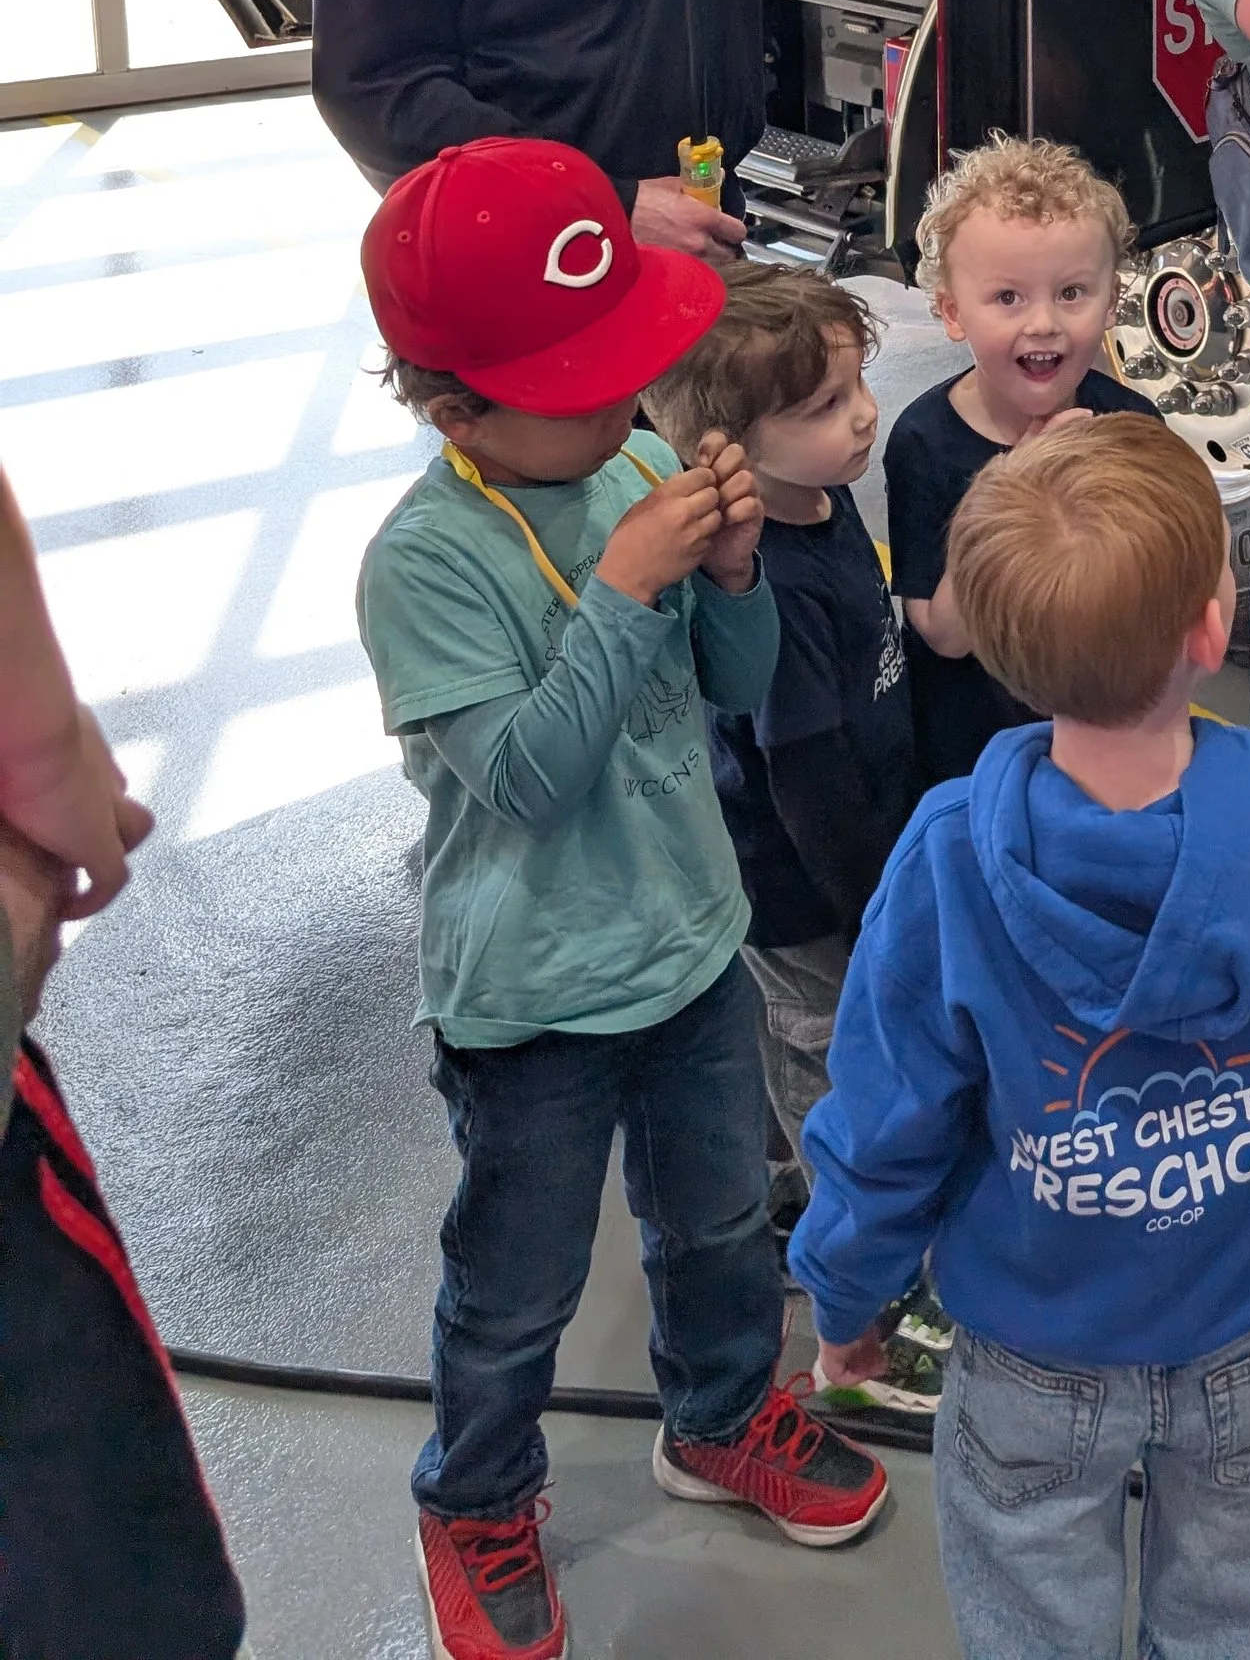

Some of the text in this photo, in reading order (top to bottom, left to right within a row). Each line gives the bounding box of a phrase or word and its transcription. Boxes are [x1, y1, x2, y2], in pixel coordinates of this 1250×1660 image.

[542, 219, 613, 288] C
[623, 747, 699, 798] WCCNS
[1016, 1121, 1118, 1168] WEST
[1145, 1205, 1205, 1233] CO-OP
